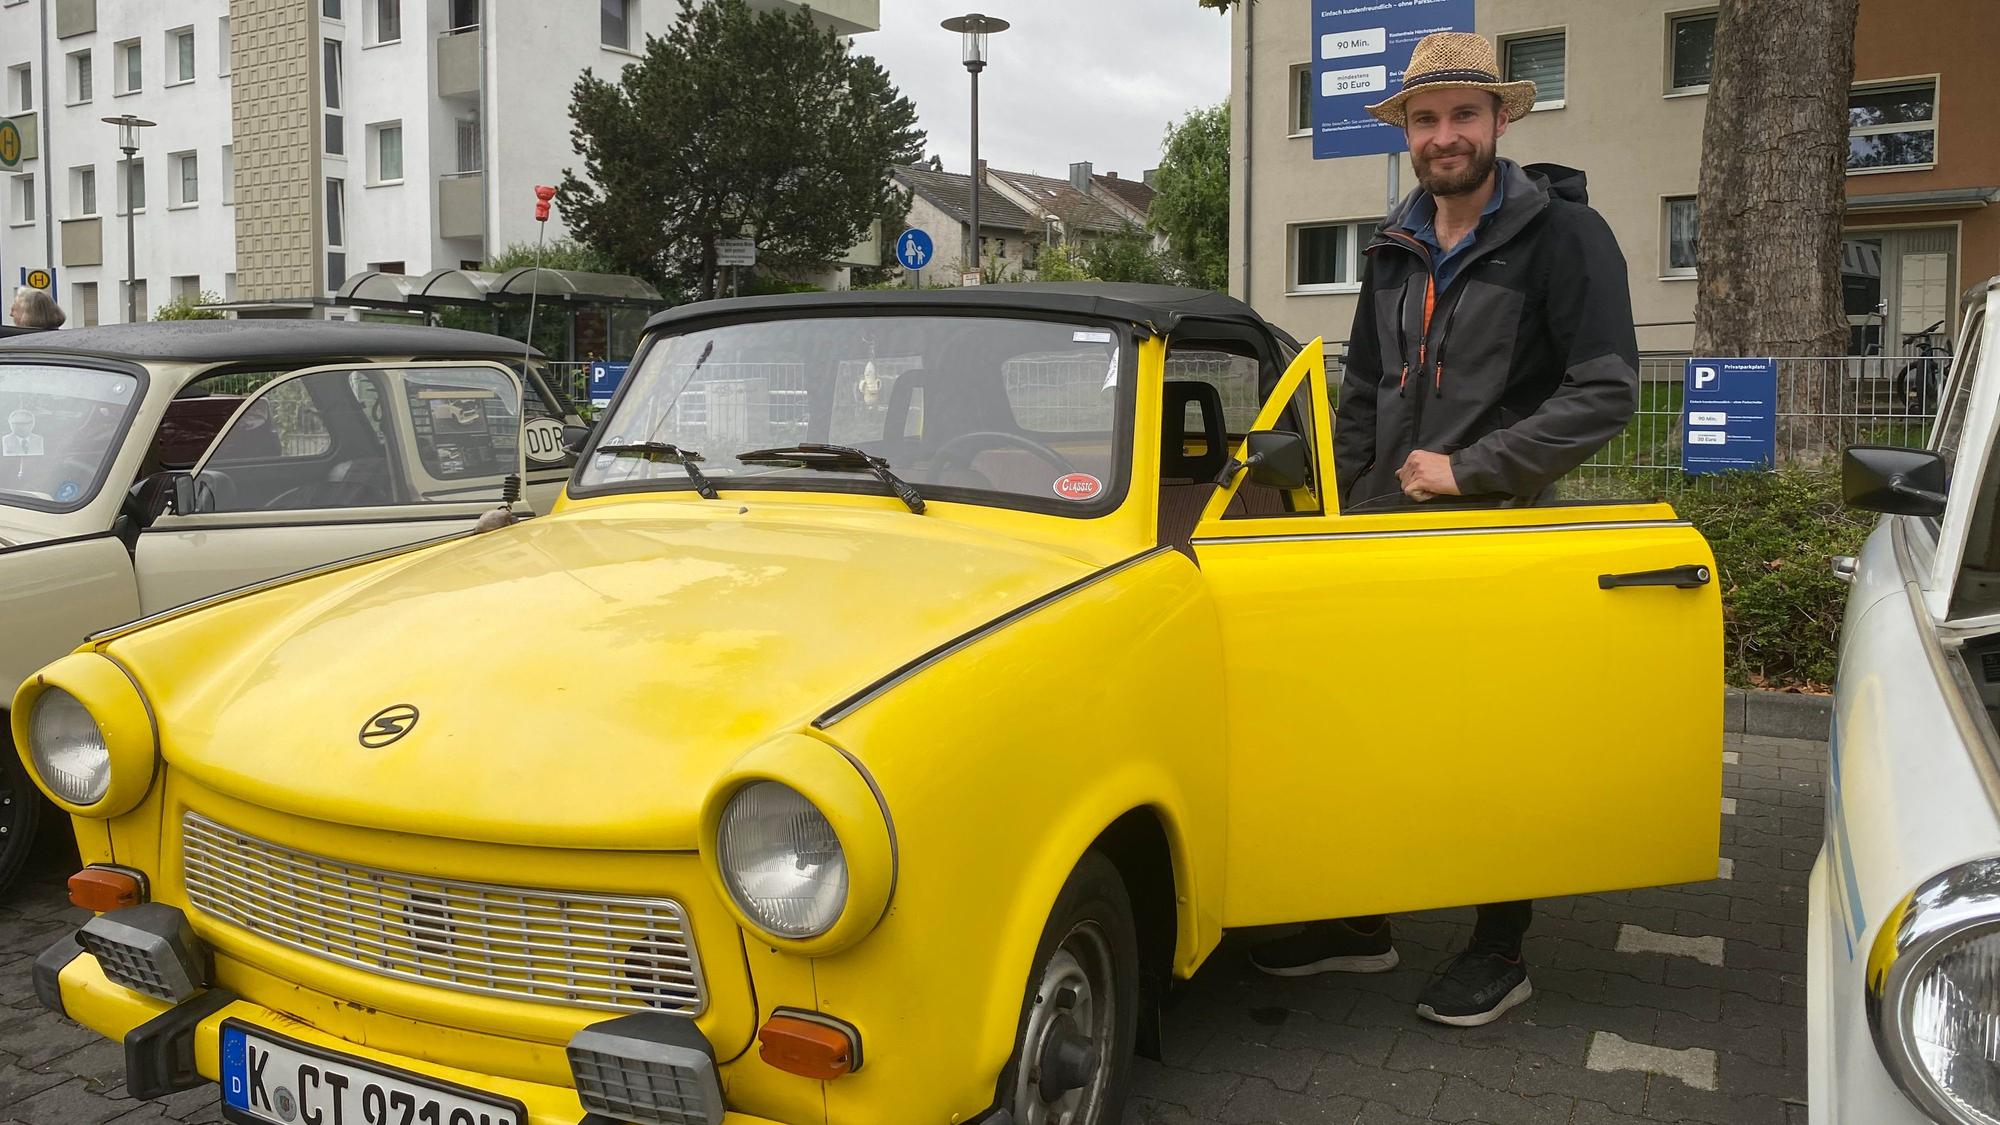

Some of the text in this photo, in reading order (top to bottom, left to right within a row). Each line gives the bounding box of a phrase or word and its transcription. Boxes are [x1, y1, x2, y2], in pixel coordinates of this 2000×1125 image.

[1343, 3, 1392, 14] kundenfreundlich
[1337, 39, 1370, 49] 90 Min.
[4, 129, 14, 157] H
[34, 274, 43, 286] H
[595, 367, 605, 382] P
[1695, 367, 1715, 389] P
[527, 427, 563, 453] DDR
[232, 1076, 240, 1093] D
[249, 1045, 272, 1112] K
[298, 1064, 349, 1125] CT
